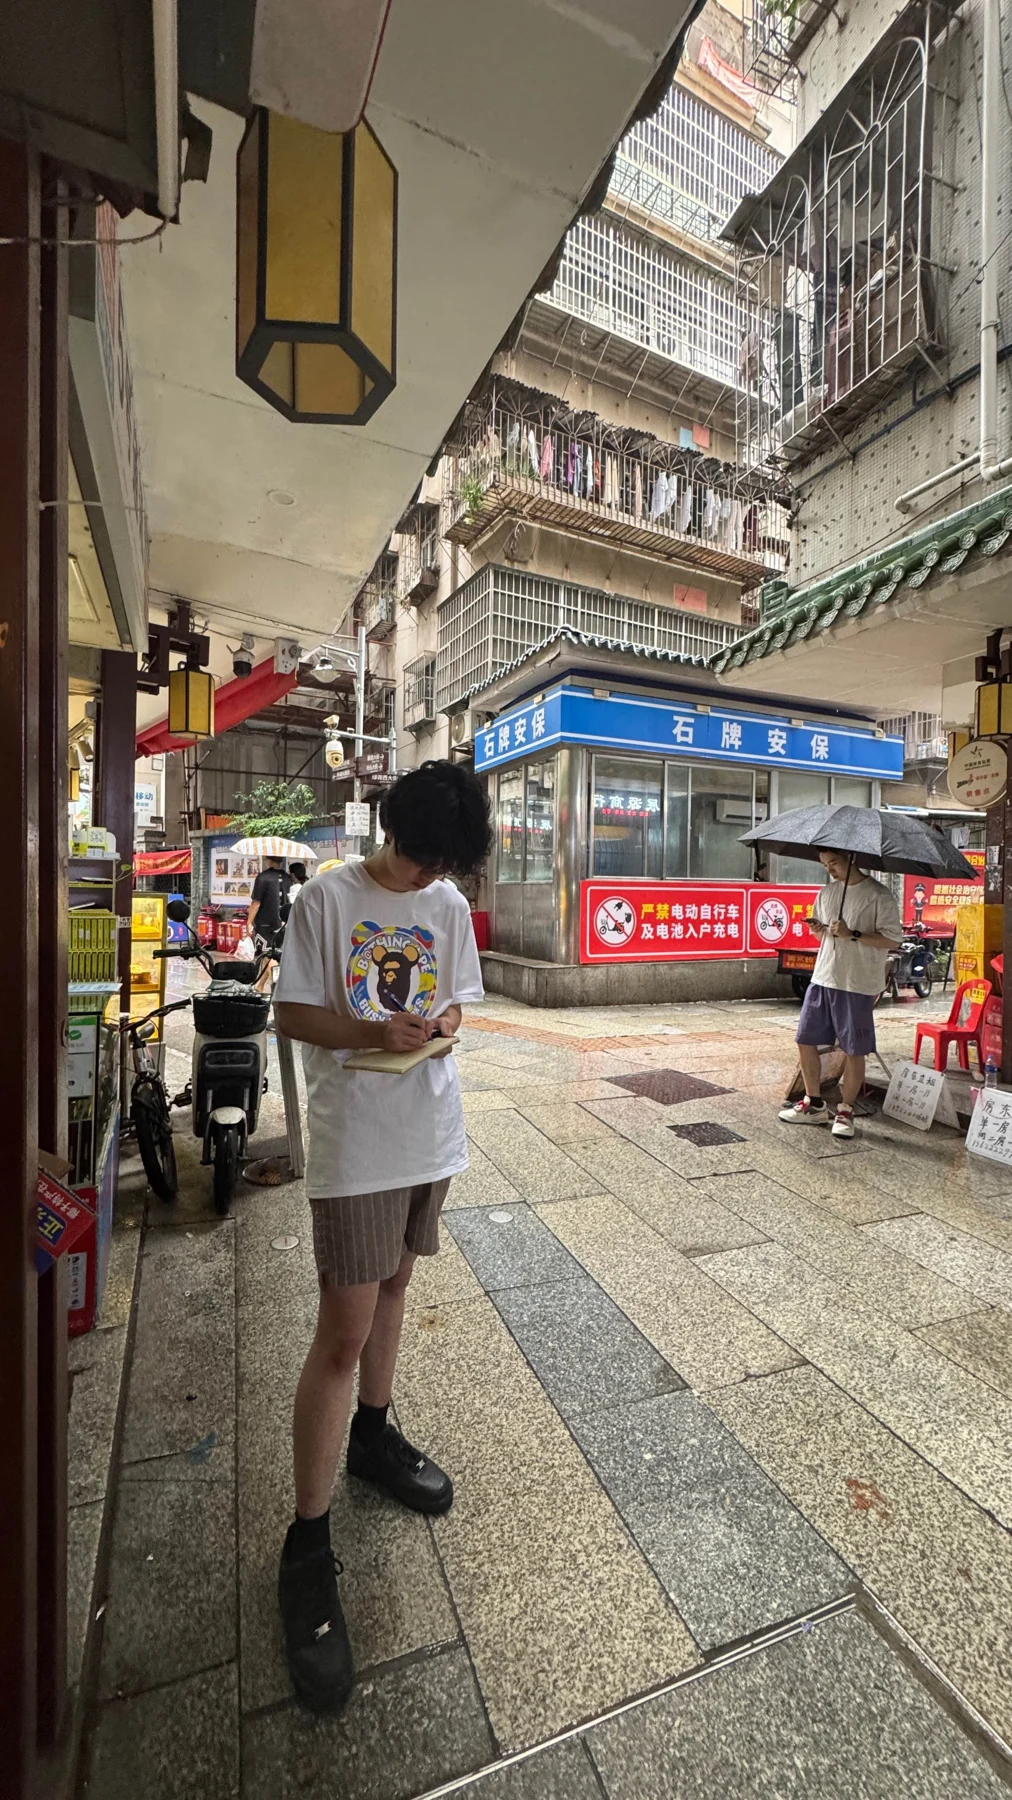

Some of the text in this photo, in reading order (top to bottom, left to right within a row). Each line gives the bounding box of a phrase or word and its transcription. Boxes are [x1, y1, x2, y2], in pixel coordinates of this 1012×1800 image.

[483, 707, 546, 759] 石牌安保
[672, 714, 830, 760] 石牌安保
[135, 791, 154, 801] 移动
[640, 903, 740, 920] 严禁电动自行车
[640, 923, 740, 940] 及电池入户充电
[982, 1098, 1012, 1118] 房东
[37, 1179, 81, 1220] 椰子特产在
